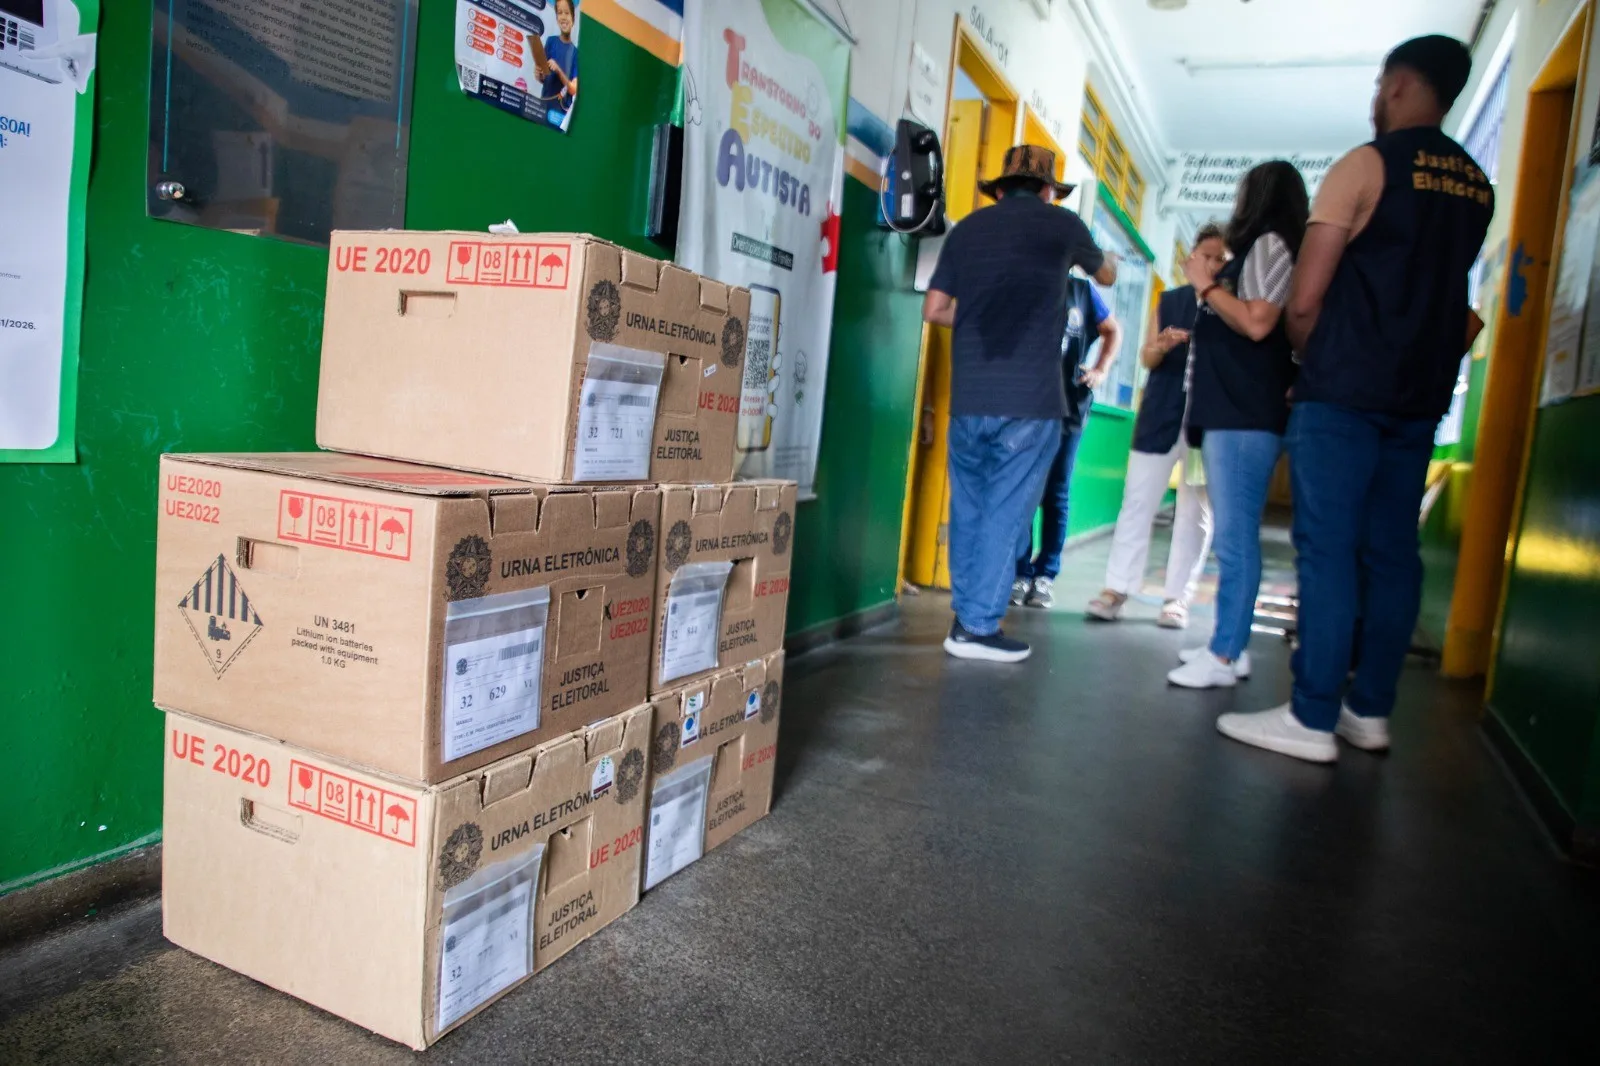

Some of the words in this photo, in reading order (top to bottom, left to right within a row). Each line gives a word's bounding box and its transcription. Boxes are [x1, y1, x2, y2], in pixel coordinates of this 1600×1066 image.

[716, 128, 810, 216] AUTISTA
[335, 246, 368, 272] UE
[374, 247, 431, 275] 2020
[483, 250, 501, 269] 08
[626, 312, 656, 334] URNA
[657, 320, 717, 347] ELETRÔNICA
[699, 391, 714, 410] UE
[664, 429, 700, 446] JUSTIÇA
[656, 446, 703, 461] ELEITORAL
[166, 474, 222, 498] UE2020
[165, 499, 221, 525] UE2022
[316, 505, 336, 528] 08
[696, 537, 720, 553] URNA
[721, 530, 769, 549] ELETRÔNICA
[501, 557, 541, 579] URNA
[544, 546, 620, 573] ELETRÔNICA
[754, 583, 767, 597] UE
[314, 614, 329, 629] UN
[332, 617, 356, 635] 3481
[726, 618, 756, 636] JUSTIÇA
[291, 638, 318, 652] packed
[319, 641, 336, 655] with
[337, 648, 379, 666] equipment
[296, 626, 324, 642] Lithium
[325, 634, 338, 645] ion
[339, 635, 374, 653] batteries
[720, 634, 758, 653] ELEITORAL
[333, 657, 346, 669] KG
[560, 661, 605, 687] JUSTIÇA
[460, 694, 473, 710] 32
[489, 685, 507, 701] 629
[551, 679, 610, 711] ELEITORAL
[172, 730, 206, 767] UE
[212, 744, 271, 788] 2020
[326, 780, 344, 805] 08
[715, 788, 744, 814] JUSTIÇA
[709, 801, 747, 831] ELEITORAL
[491, 820, 530, 851] URNA
[590, 844, 609, 869] UE
[613, 825, 643, 857] 2020
[549, 889, 593, 927] JUSTIÇA
[539, 904, 598, 950] ELEITORAL
